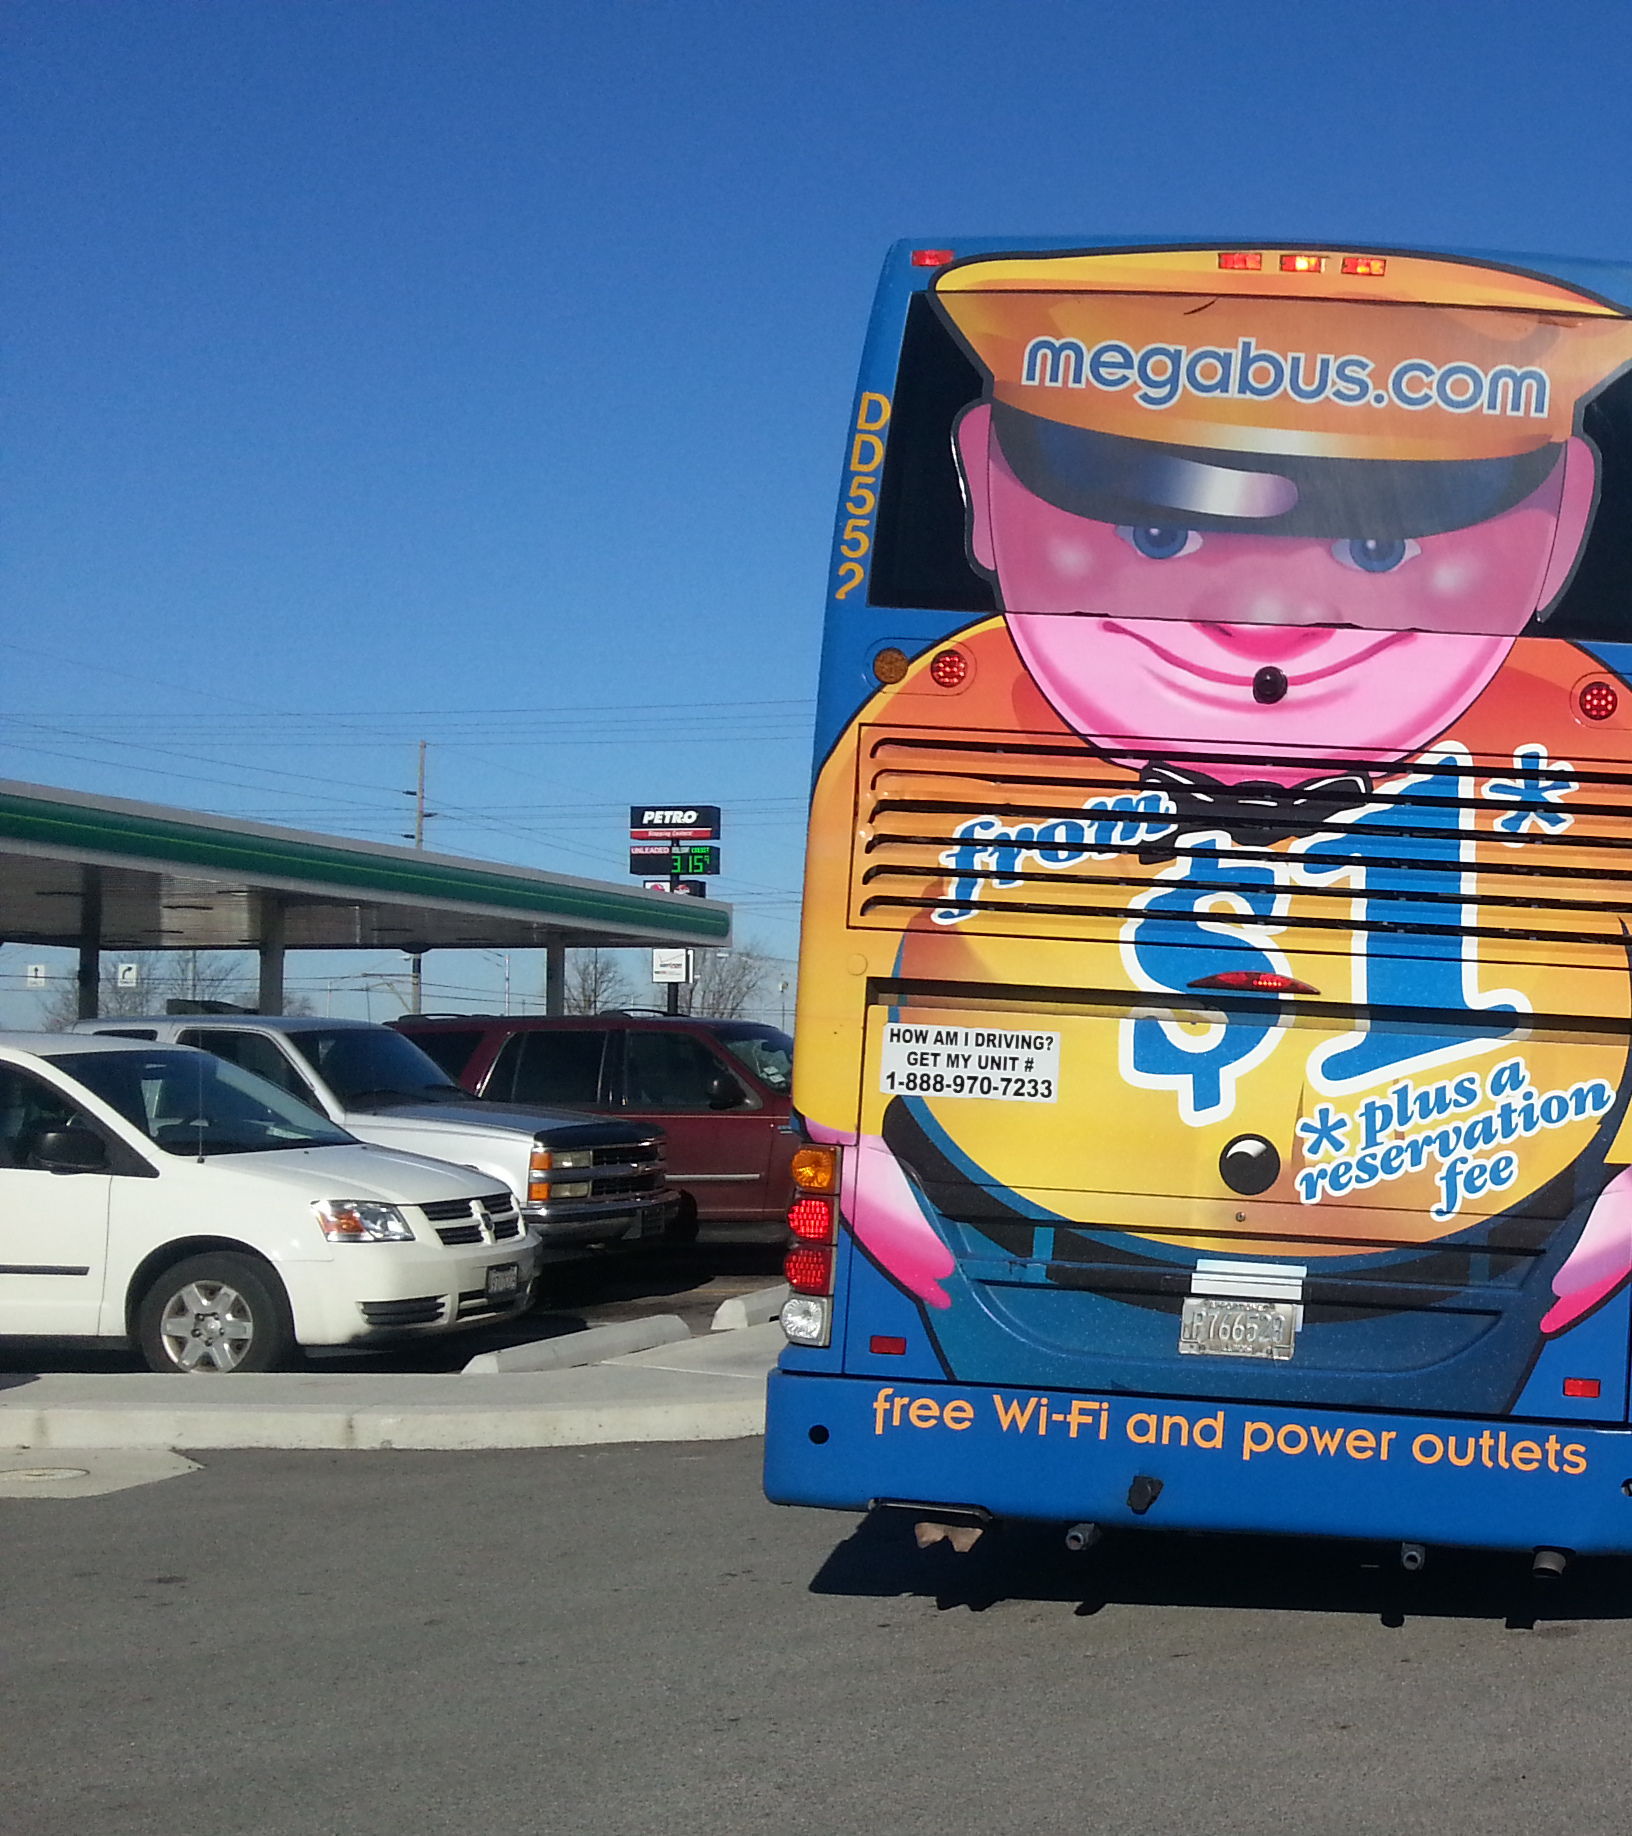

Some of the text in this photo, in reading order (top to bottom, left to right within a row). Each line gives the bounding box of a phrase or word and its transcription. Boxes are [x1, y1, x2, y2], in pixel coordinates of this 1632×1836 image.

[1021, 336, 1550, 419] megabus.com
[642, 811, 697, 824] PETRO
[933, 791, 1178, 924] from
[889, 1027, 1054, 1051] HOW AM I DRIVING?
[906, 1051, 1036, 1073] GET MY UNIT #
[885, 1070, 1053, 1099] 1-888-970-7233
[1489, 1058, 1526, 1097] a
[1298, 1081, 1613, 1202] reservation
[1431, 1152, 1516, 1221] fee
[873, 1387, 1588, 1475] free Wi-Fi and power outlets
